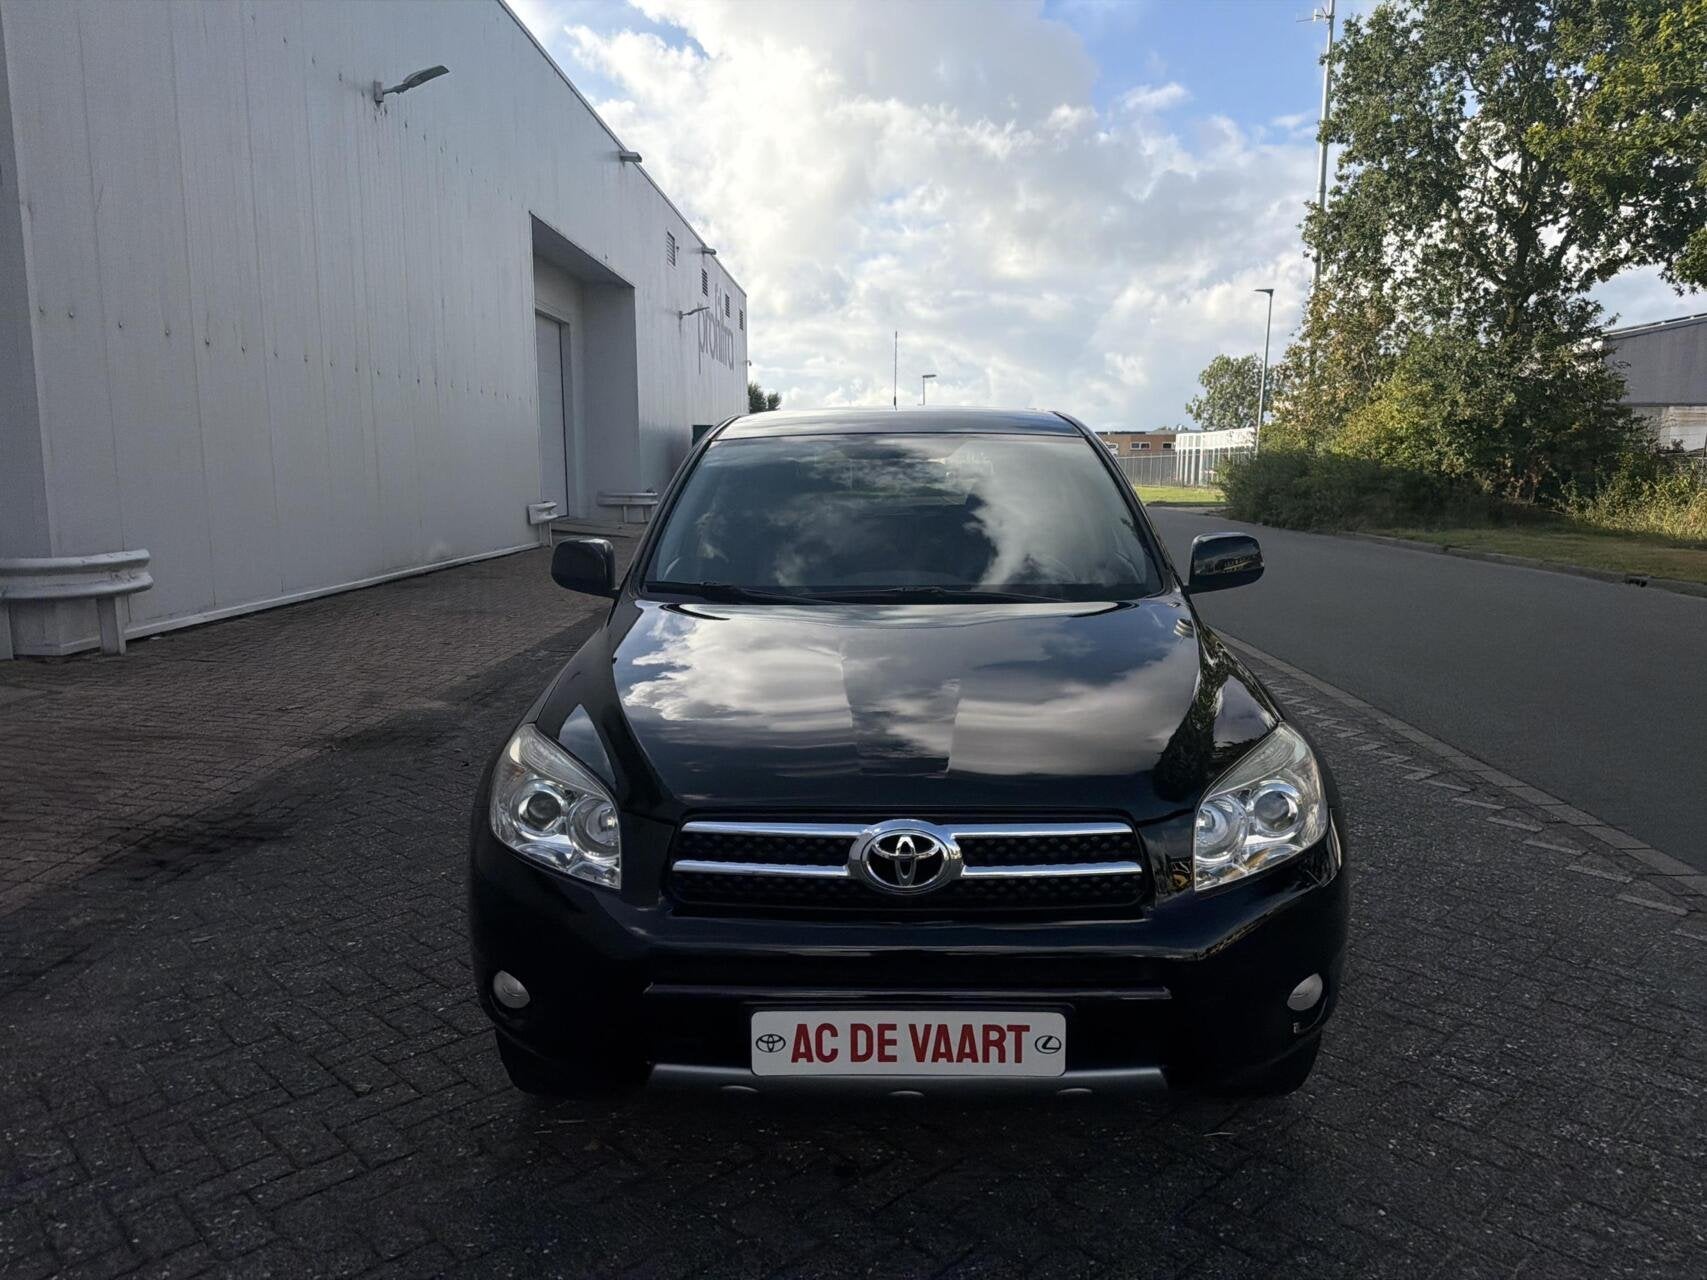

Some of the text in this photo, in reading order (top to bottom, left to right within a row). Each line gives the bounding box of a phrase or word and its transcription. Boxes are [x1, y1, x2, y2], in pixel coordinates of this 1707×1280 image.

[791, 1023, 1030, 1063] AC DE VAART
